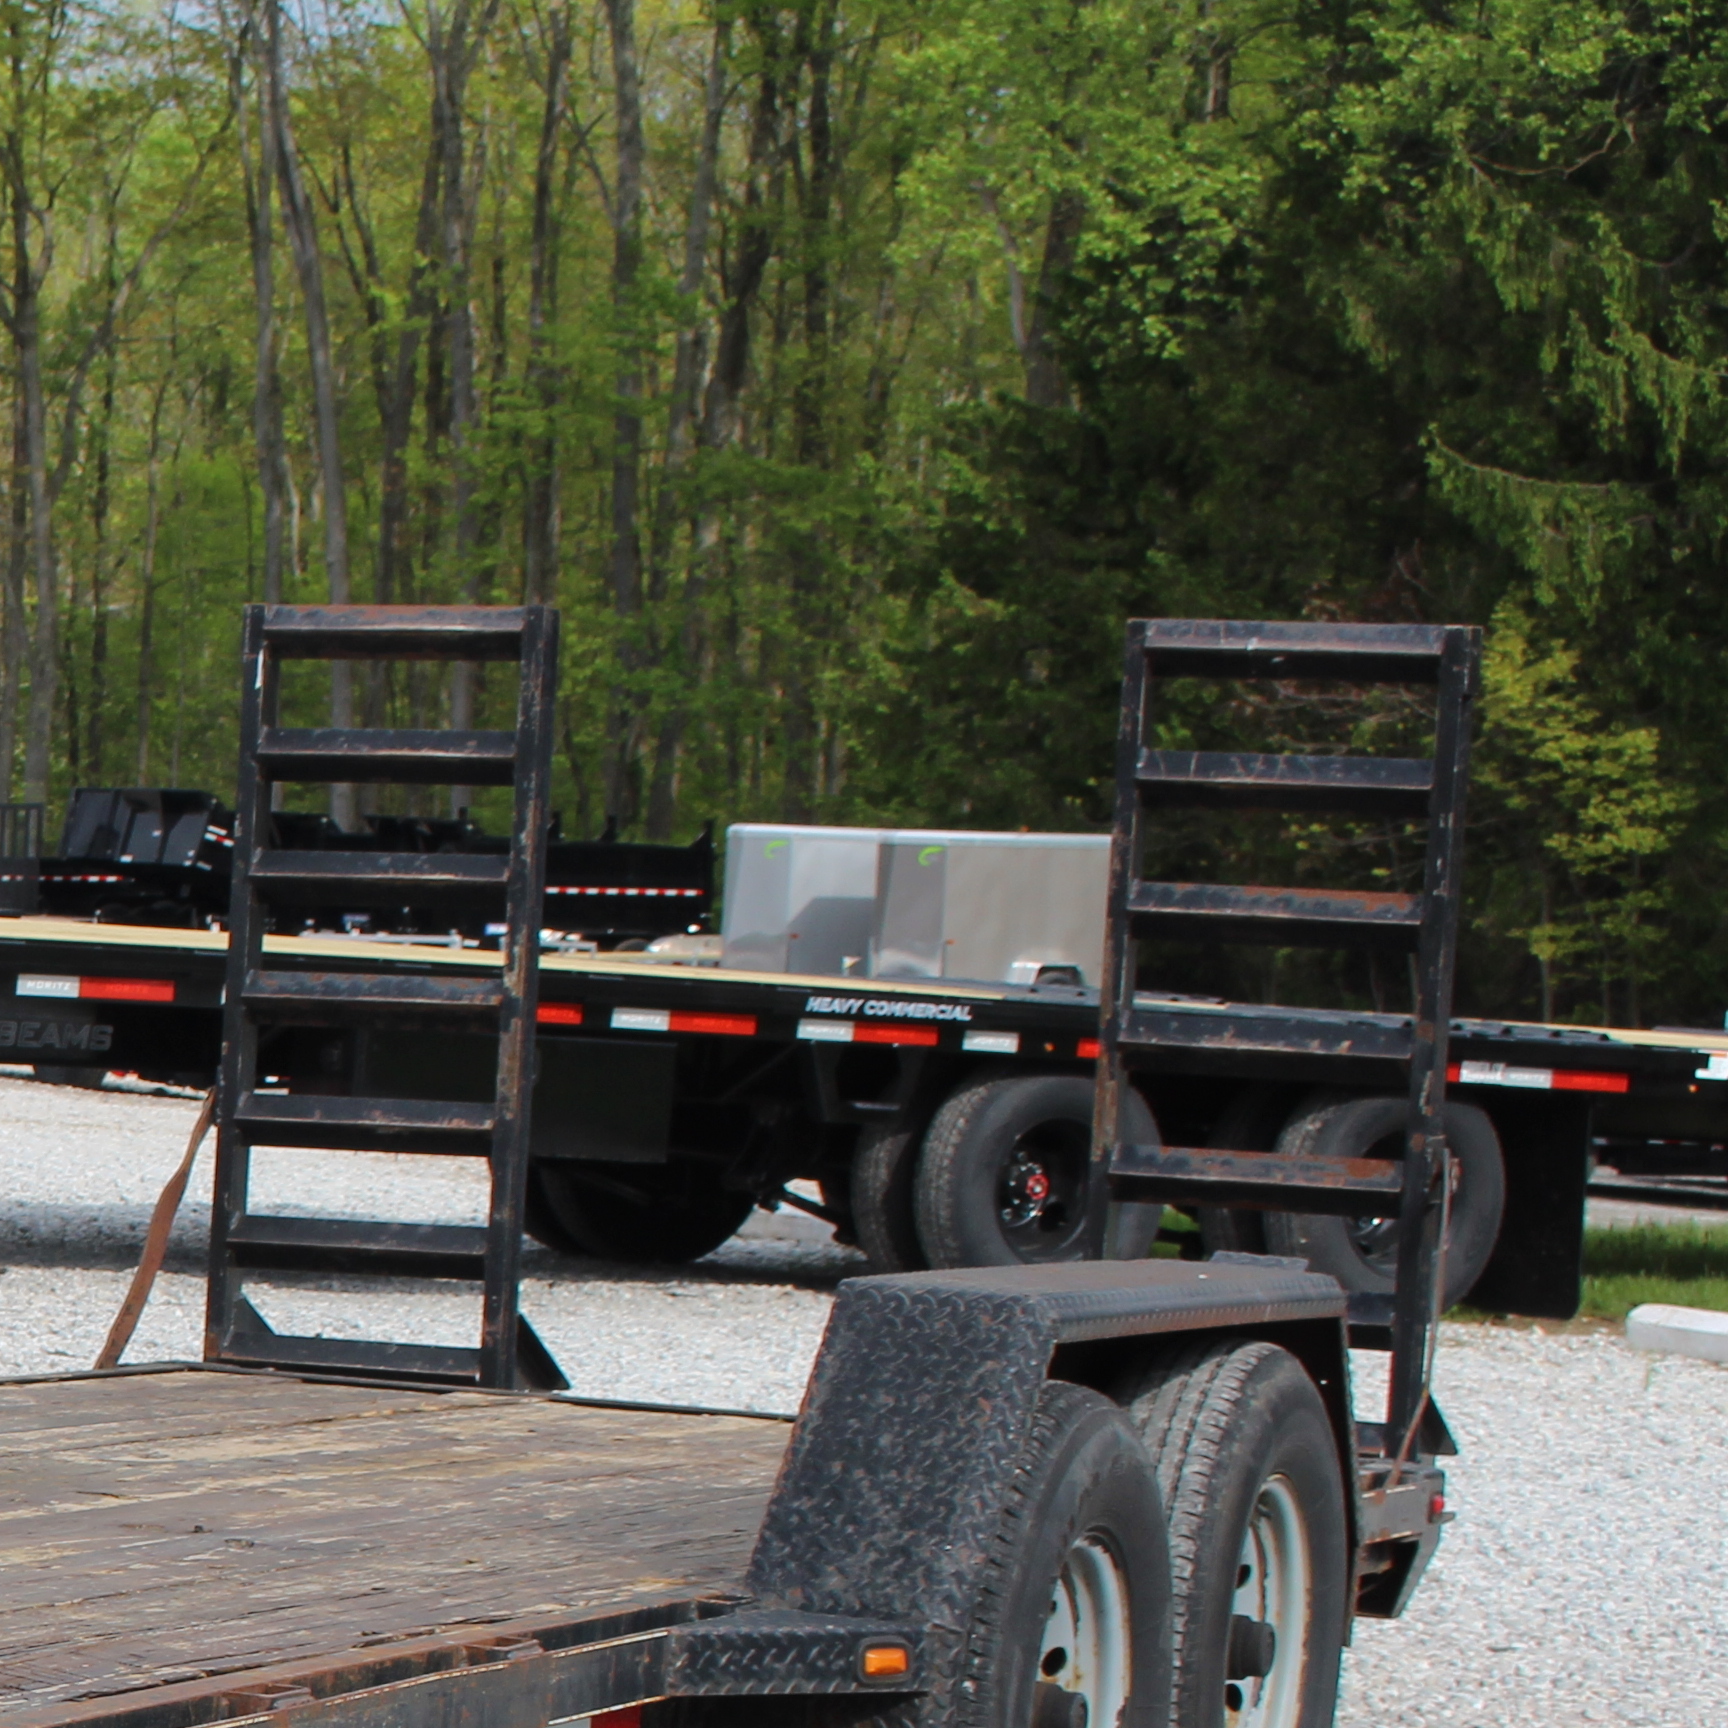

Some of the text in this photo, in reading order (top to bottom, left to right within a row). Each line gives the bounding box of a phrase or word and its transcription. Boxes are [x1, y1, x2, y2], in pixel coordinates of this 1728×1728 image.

[25, 980, 73, 993] MORITZ
[805, 996, 973, 1021] HEAVY COMMERCIAL
